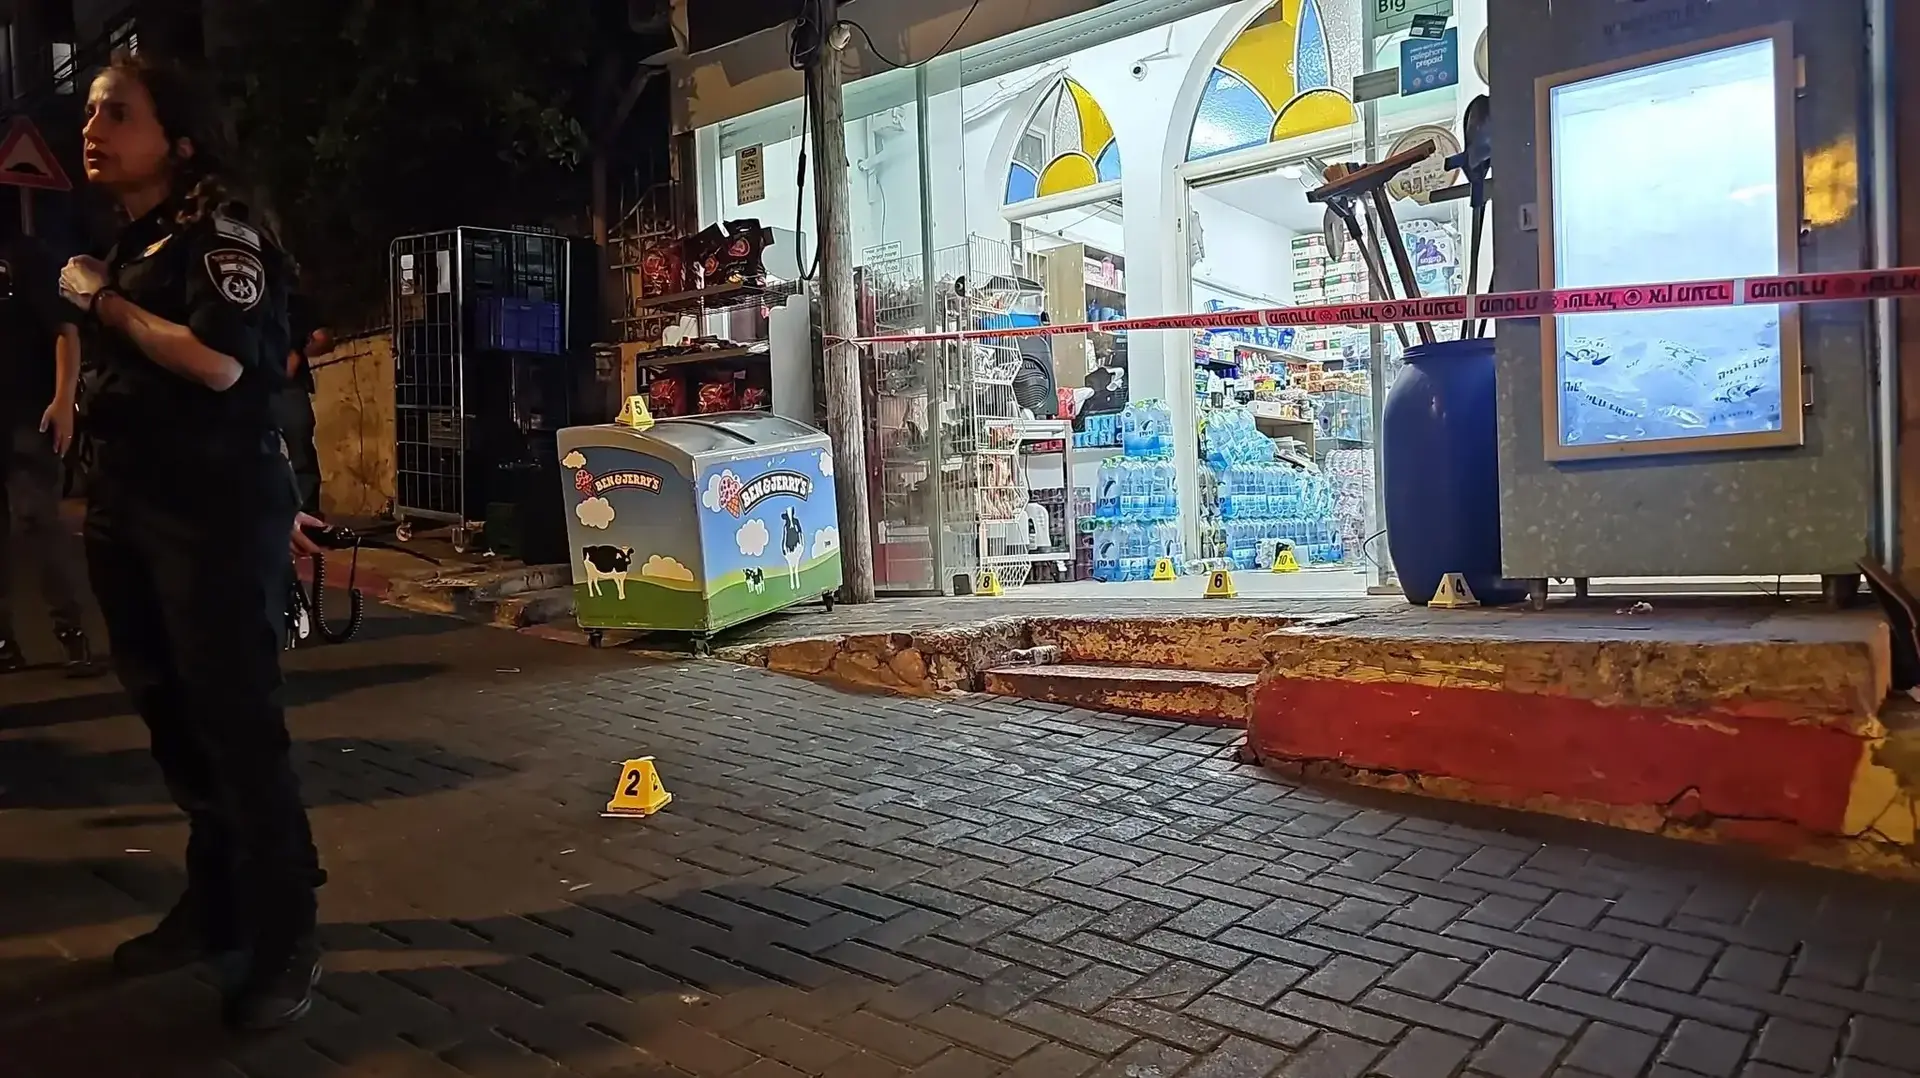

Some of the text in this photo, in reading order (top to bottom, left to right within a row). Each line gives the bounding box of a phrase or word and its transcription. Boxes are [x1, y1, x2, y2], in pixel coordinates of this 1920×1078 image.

[1416, 54, 1443, 69] prepaid
[1269, 310, 1316, 324] משטרת
[1335, 306, 1379, 322] ישראל
[1401, 300, 1420, 318] אין
[1423, 300, 1464, 316] מעבר
[1479, 296, 1538, 313] משטרת
[1563, 291, 1617, 309] ישראל
[1649, 285, 1673, 304] אין
[1677, 285, 1729, 303] מעבר
[1751, 279, 1829, 299] משטרת
[634, 401, 642, 416] 5
[1159, 561, 1167, 573] 9
[1278, 554, 1288, 565] 10
[983, 575, 991, 588] 8
[1214, 573, 1223, 588] 6
[1455, 578, 1466, 597] 4
[624, 769, 641, 797] 2
